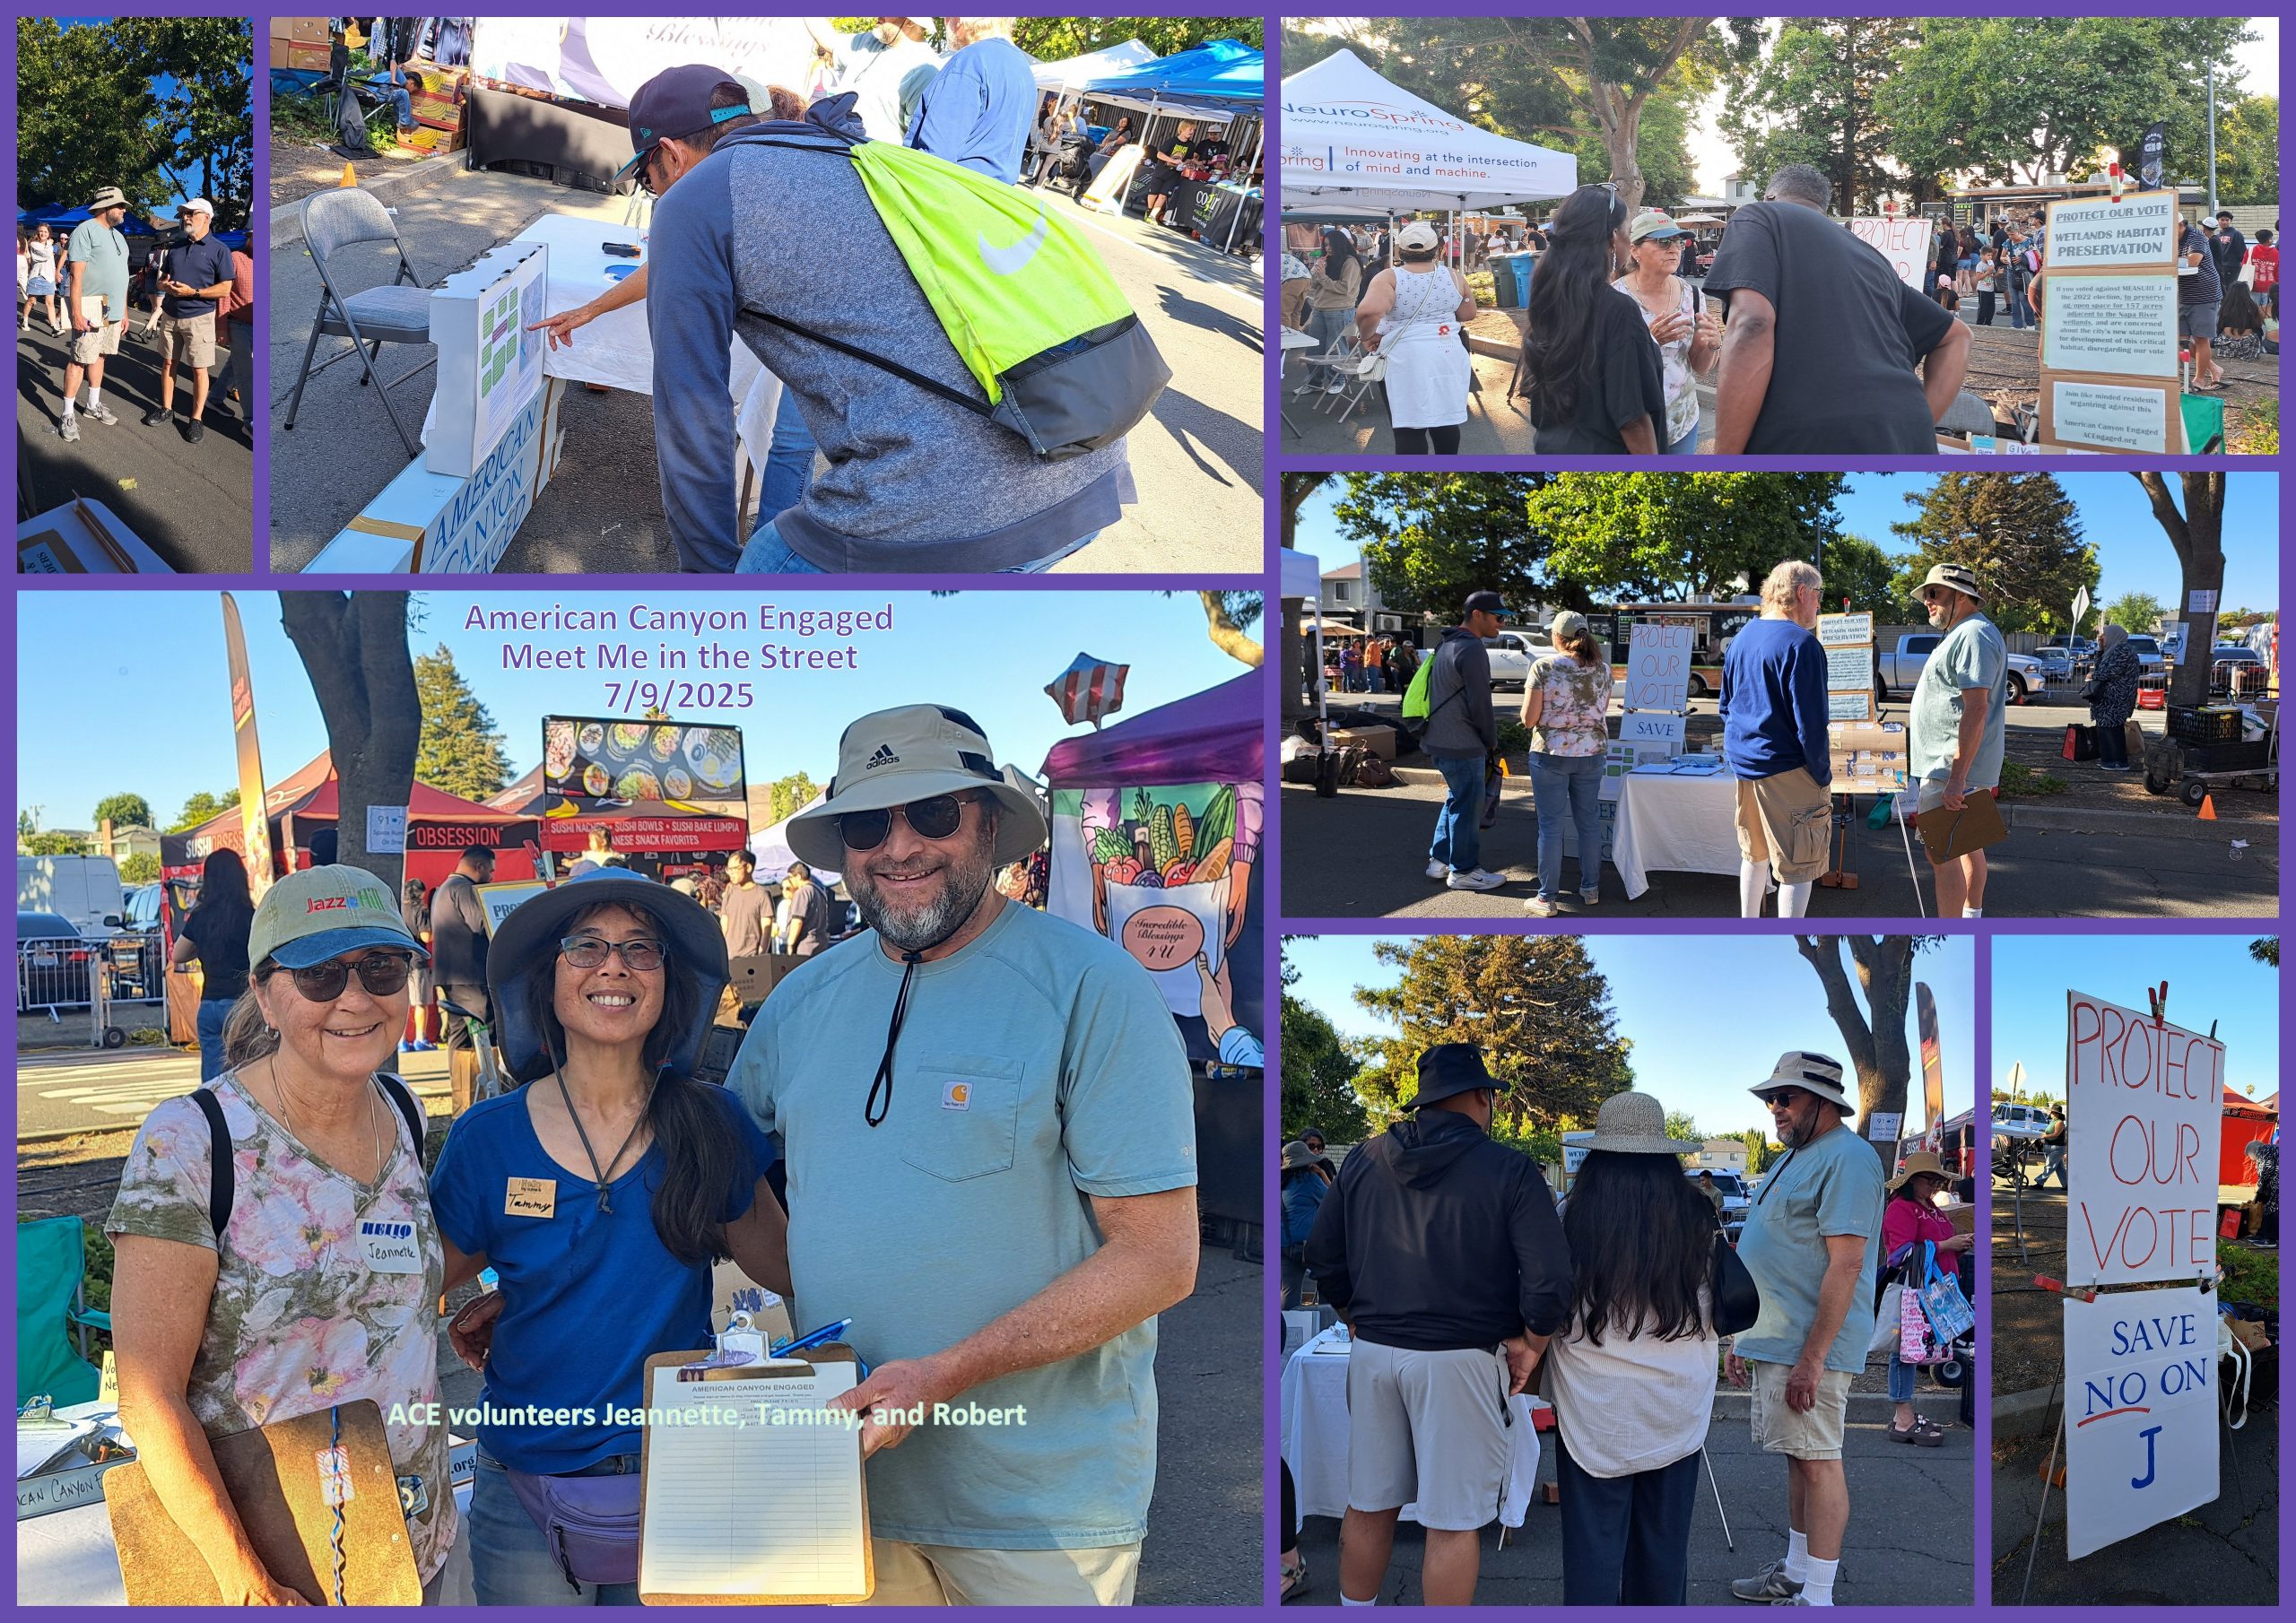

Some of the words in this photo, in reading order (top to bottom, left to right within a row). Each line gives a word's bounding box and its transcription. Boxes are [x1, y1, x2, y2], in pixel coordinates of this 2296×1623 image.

[1290, 117, 1449, 135] www.neurospring.org
[1345, 146, 1422, 162] Innovating
[1426, 152, 1438, 161] at
[1443, 153, 1463, 163] the
[1467, 154, 1537, 169] intersection
[1345, 161, 1360, 171] of
[1366, 163, 1401, 174] mind
[1406, 165, 1431, 176] and
[1435, 167, 1491, 178] machine.
[2056, 210, 2106, 221] PROTECT
[2109, 207, 2134, 218] OUR
[2137, 204, 2169, 215] VOTE
[1852, 220, 1928, 251] PROTECT
[2056, 230, 2113, 241] WETLANDS
[2117, 227, 2167, 239] HABITAT
[2057, 242, 2162, 257] PRESERVATION
[2070, 335, 2113, 343] development
[2087, 345, 2132, 354] disregarding
[2080, 391, 2093, 399] like
[2095, 392, 2121, 401] minded
[2123, 395, 2158, 404] residents
[2070, 400, 2107, 410] organizing
[2108, 404, 2135, 412] against
[2137, 405, 2152, 413] this
[2064, 420, 2096, 429] American
[2098, 422, 2125, 433] Canyon
[2126, 426, 2159, 436] Engaged
[2083, 432, 2137, 445] ACEngaged.org
[430, 400, 539, 567] AMERICAN
[1631, 626, 1691, 648] PROTECT
[1641, 655, 1680, 677] OUR
[1631, 683, 1684, 706] VOTE
[1637, 721, 1675, 737] SAVE
[866, 756, 900, 770] adidas
[378, 815, 389, 826] 91
[551, 822, 575, 835] SUSHI
[614, 821, 636, 833] SUSHI
[638, 821, 664, 832] BOWLS
[672, 820, 694, 832] SUSHI
[694, 820, 713, 832] BAKE
[714, 821, 740, 833] LUMPIA
[186, 835, 212, 859] SUSHI
[636, 835, 659, 846] SNACK
[660, 834, 700, 846] FAVORITES
[307, 897, 347, 914] Jazz
[357, 888, 386, 912] Hill
[1135, 918, 1187, 931] Incredible
[1137, 929, 1186, 944] Blessings
[1161, 944, 1175, 959] U
[2074, 1002, 2223, 1105] PROTECT
[2109, 1115, 2202, 1185] OUR
[509, 1193, 553, 1213] Tammy
[361, 1222, 412, 1239] HELLO
[2081, 1202, 2213, 1271] VOTE
[368, 1242, 416, 1260] Jeannette
[2110, 1313, 2197, 1358] SAVE
[773, 1384, 814, 1392] ENGAGED
[2083, 1371, 2147, 1416] NO
[2160, 1357, 2209, 1397] ON
[2131, 1425, 2163, 1490] J
[51, 1477, 94, 1503] CANYON
